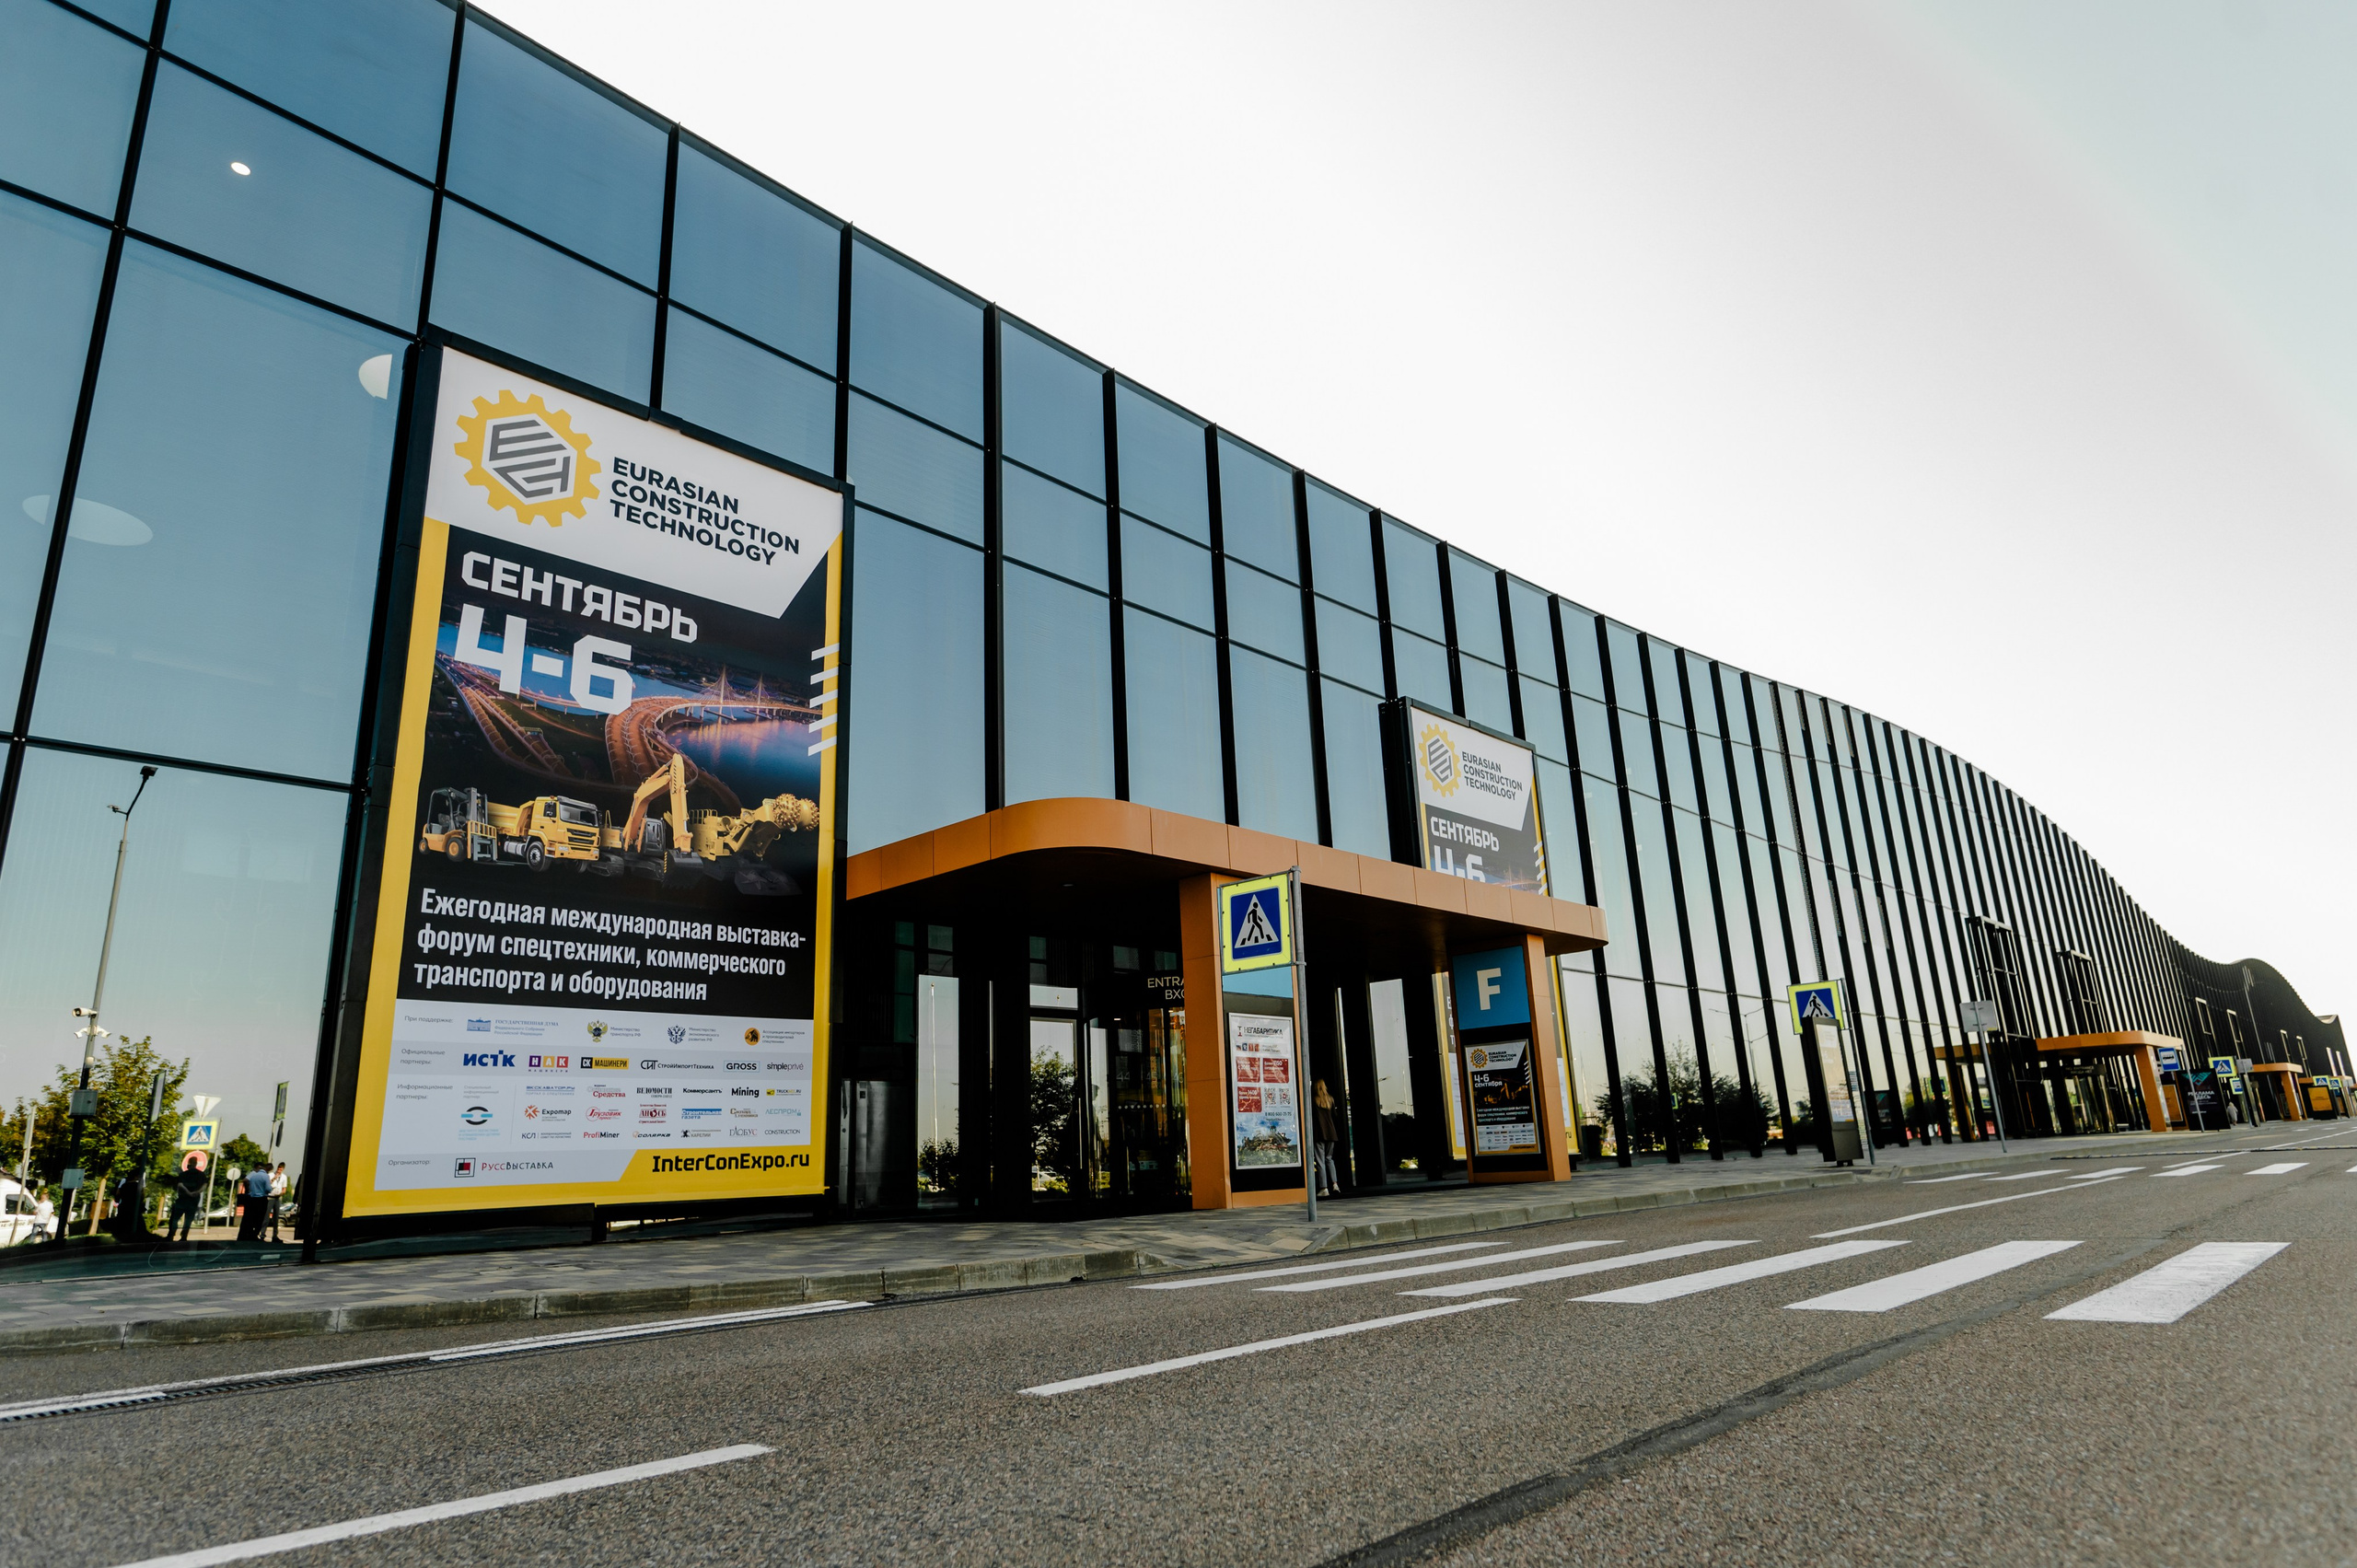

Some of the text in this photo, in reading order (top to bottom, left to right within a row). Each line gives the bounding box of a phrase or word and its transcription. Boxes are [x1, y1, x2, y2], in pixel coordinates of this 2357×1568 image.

[612, 457, 739, 514] EURASIAN
[610, 479, 799, 554] CONSTRUCTION
[610, 499, 776, 565] TECHNOLOGY
[461, 551, 698, 643] СЕНТЯБРЬ
[454, 603, 633, 714] 4-6
[1462, 750, 1502, 773] EURASIAN
[1463, 763, 1523, 792] CONSTRUCTION
[1464, 775, 1516, 801] TECHNOLOGY
[1430, 816, 1500, 852] СЕНТЯБРЬ
[1434, 845, 1486, 883] 4-6
[421, 888, 806, 948] Ежегодная международная выставка-
[417, 923, 785, 976] форум спецтехники, коммерческого
[413, 963, 707, 1001] транспорта и оборудования
[1476, 967, 1502, 1011] F
[400, 1058, 433, 1066] партнеры:
[401, 1048, 446, 1056] Официальные
[594, 1059, 628, 1068] МАШИНЕРИ
[726, 1063, 757, 1071] GROSS
[1473, 1074, 1490, 1083] 4-6
[731, 1086, 760, 1098] Mining
[1474, 1080, 1503, 1088] сентября
[388, 1158, 432, 1167] Организатор:
[652, 1153, 809, 1173] InterConExpo.ru
